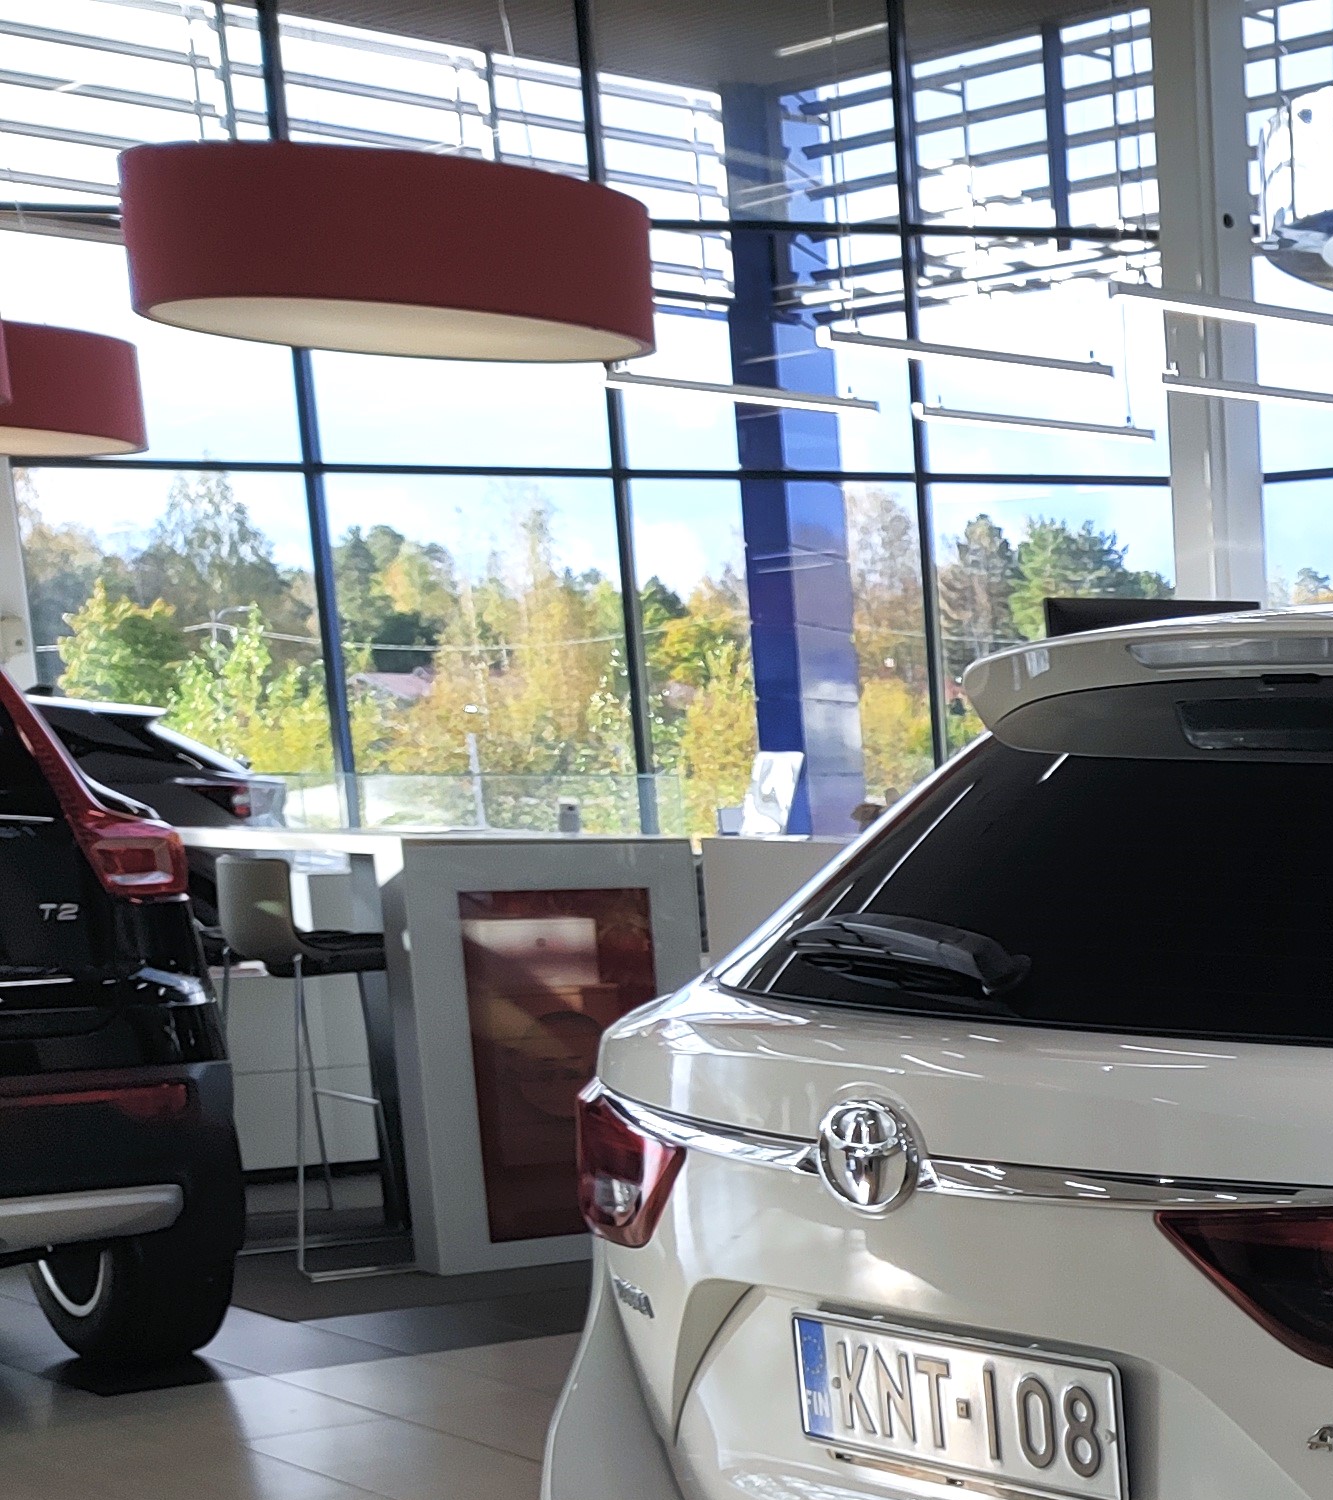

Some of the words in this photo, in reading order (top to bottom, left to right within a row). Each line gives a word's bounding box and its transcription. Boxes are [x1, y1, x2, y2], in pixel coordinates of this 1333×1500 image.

[39, 902, 79, 920] T2
[806, 1388, 831, 1418] FIN
[835, 1340, 1102, 1479] KNT-108
